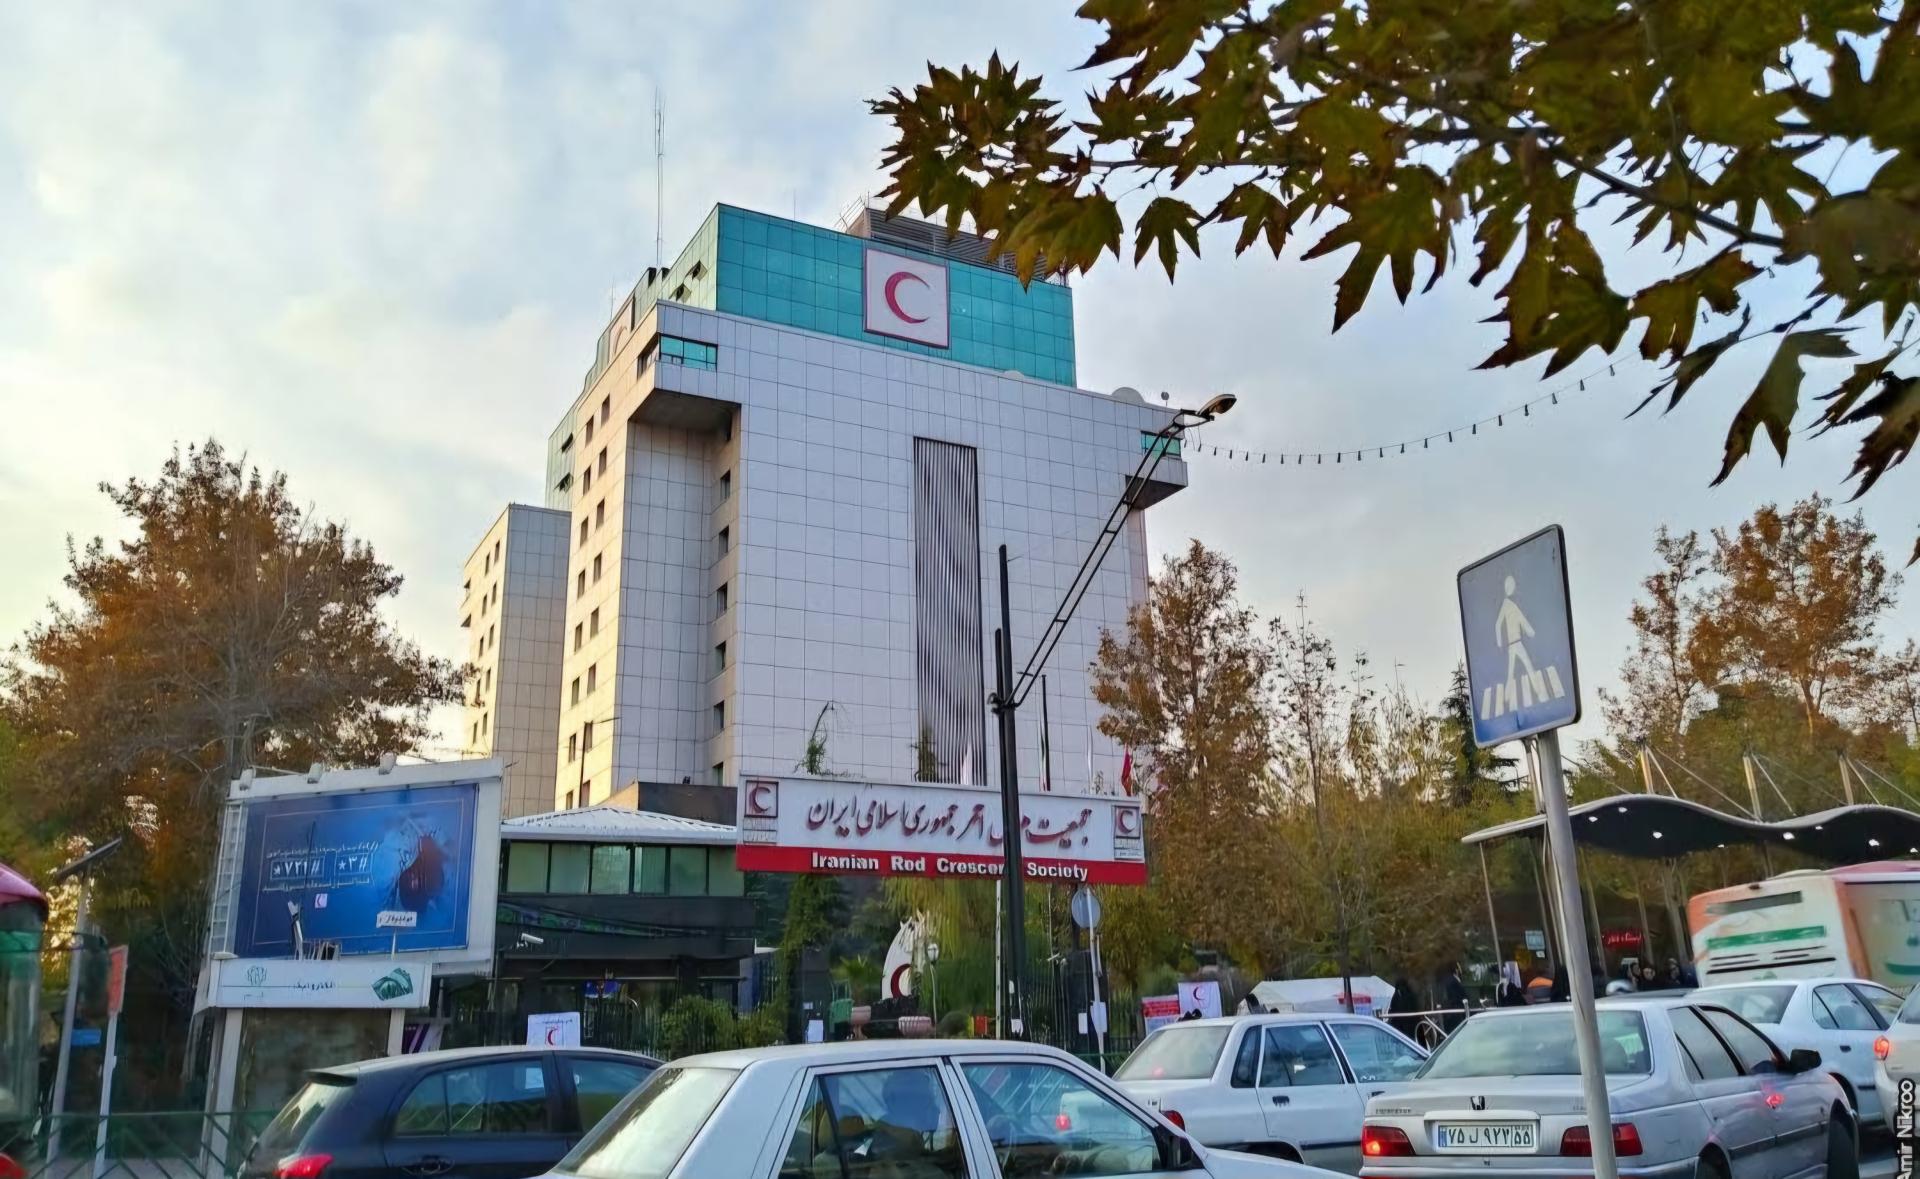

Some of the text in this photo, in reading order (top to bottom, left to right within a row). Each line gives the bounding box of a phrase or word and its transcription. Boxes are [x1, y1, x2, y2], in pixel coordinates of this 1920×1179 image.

[812, 851, 1088, 882] Iranian Red Crescen Society
[1448, 1127, 1465, 1144] ۷۵
